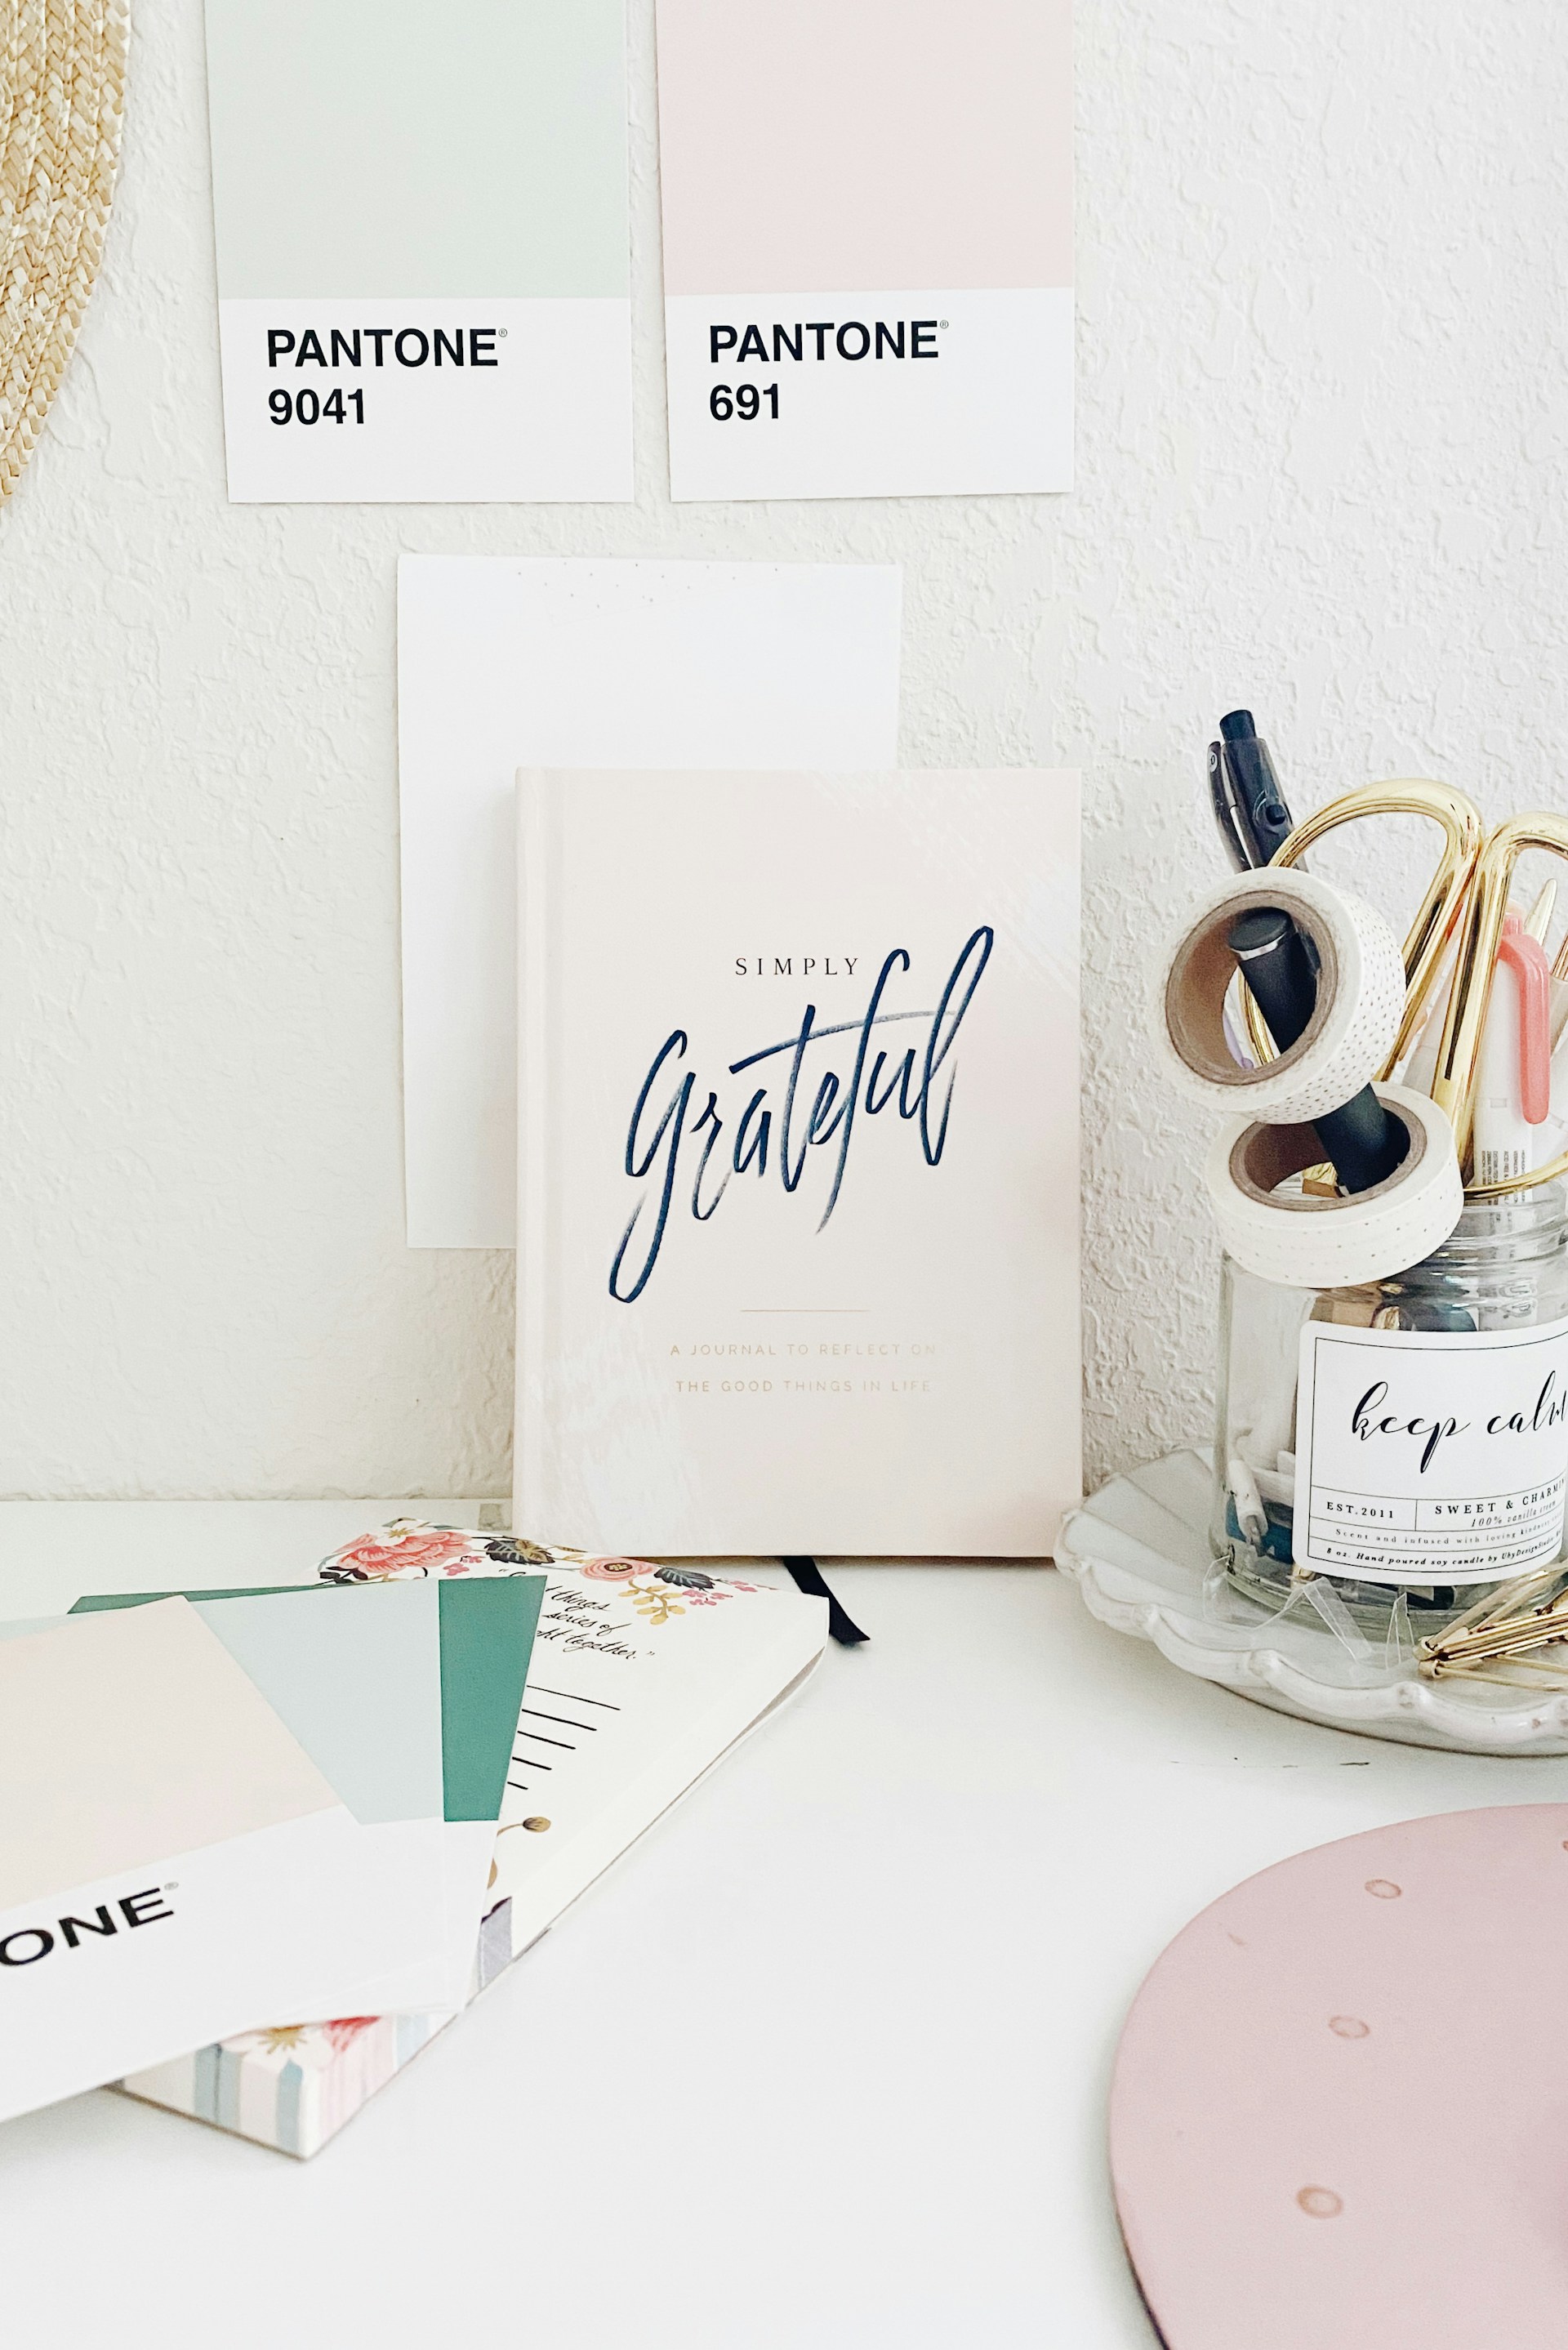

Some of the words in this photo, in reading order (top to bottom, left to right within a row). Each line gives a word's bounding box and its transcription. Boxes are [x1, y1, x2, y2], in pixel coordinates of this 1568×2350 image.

[268, 388, 367, 425] 9041
[708, 383, 782, 421] 691
[735, 957, 860, 976] SIMPLY
[608, 925, 994, 1303] grateful
[670, 1344, 680, 1356] A
[690, 1344, 777, 1356] JOURNAL
[786, 1344, 808, 1356] TO
[819, 1344, 900, 1356] REFLECT
[911, 1344, 936, 1356] ON
[675, 1380, 710, 1392] THE
[721, 1380, 773, 1392] GOOD
[783, 1380, 853, 1392] THINGS
[863, 1380, 881, 1392] IN
[892, 1380, 930, 1392] LIFE
[1352, 1381, 1471, 1474] keep
[1486, 1371, 1568, 1434] calm
[1326, 1501, 1394, 1518] EST.2011
[1435, 1502, 1496, 1514] SWEET
[1506, 1500, 1513, 1509] &
[1471, 1515, 1503, 1527] 100%
[1507, 1508, 1536, 1523] vanilla
[1335, 1528, 1368, 1540] Scent
[1405, 1536, 1450, 1545] infused
[1456, 1535, 1480, 1544] with
[1486, 1532, 1516, 1541] loving
[1356, 1553, 1384, 1563] Hand
[1388, 1557, 1427, 1567] poured
[1452, 1555, 1484, 1565] candle
[1488, 1554, 1498, 1563] by
[551, 1589, 612, 1612] things
[542, 1612, 598, 1628] series
[599, 1622, 632, 1637] of
